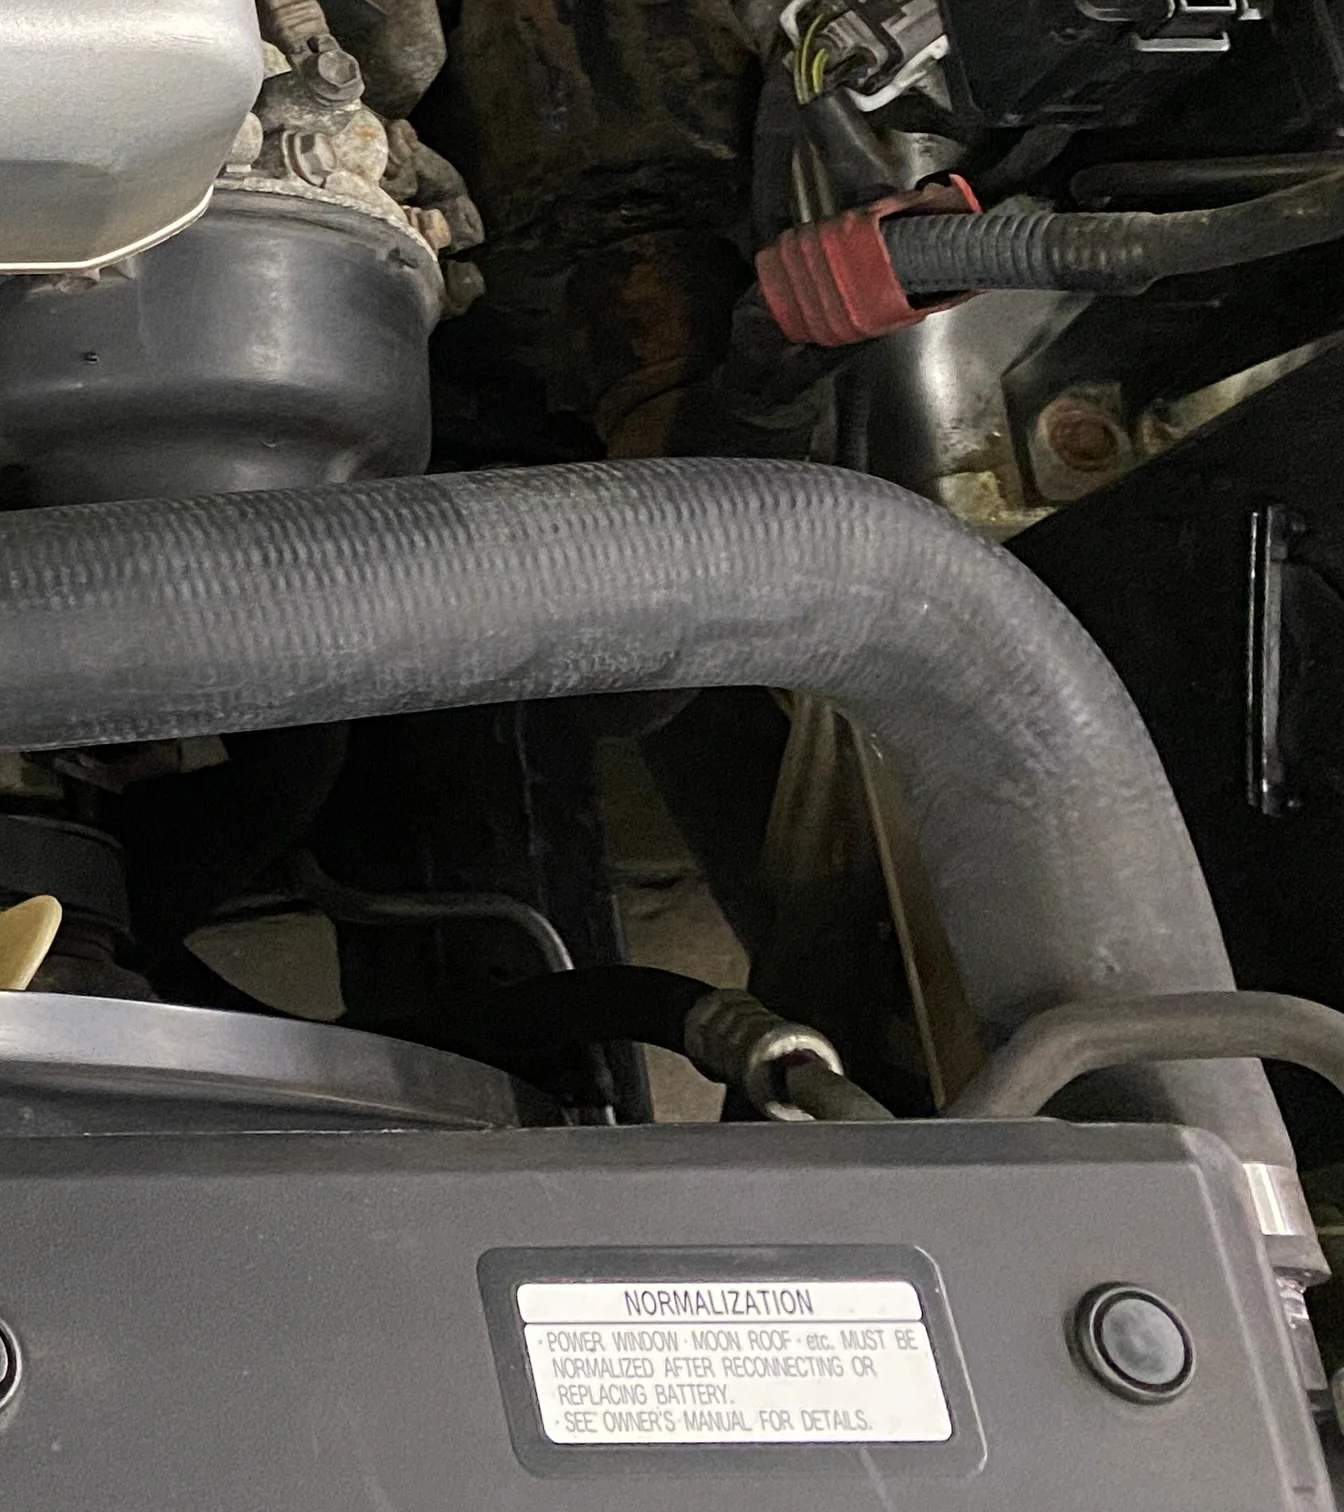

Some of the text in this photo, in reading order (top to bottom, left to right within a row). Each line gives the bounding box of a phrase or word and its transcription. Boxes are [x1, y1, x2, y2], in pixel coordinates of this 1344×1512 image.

[624, 1289, 815, 1317] NORMALIZATION
[547, 1330, 918, 1353] POWER WINDOW MOON ROOF etc. MUST BE
[552, 1356, 878, 1379] NORMALIZED AFTER RECONNECTING OR
[559, 1383, 735, 1406] REPLACING BATTERY.
[565, 1410, 873, 1433] SEE OWNER'S MANUAL FOR DETAILS.
